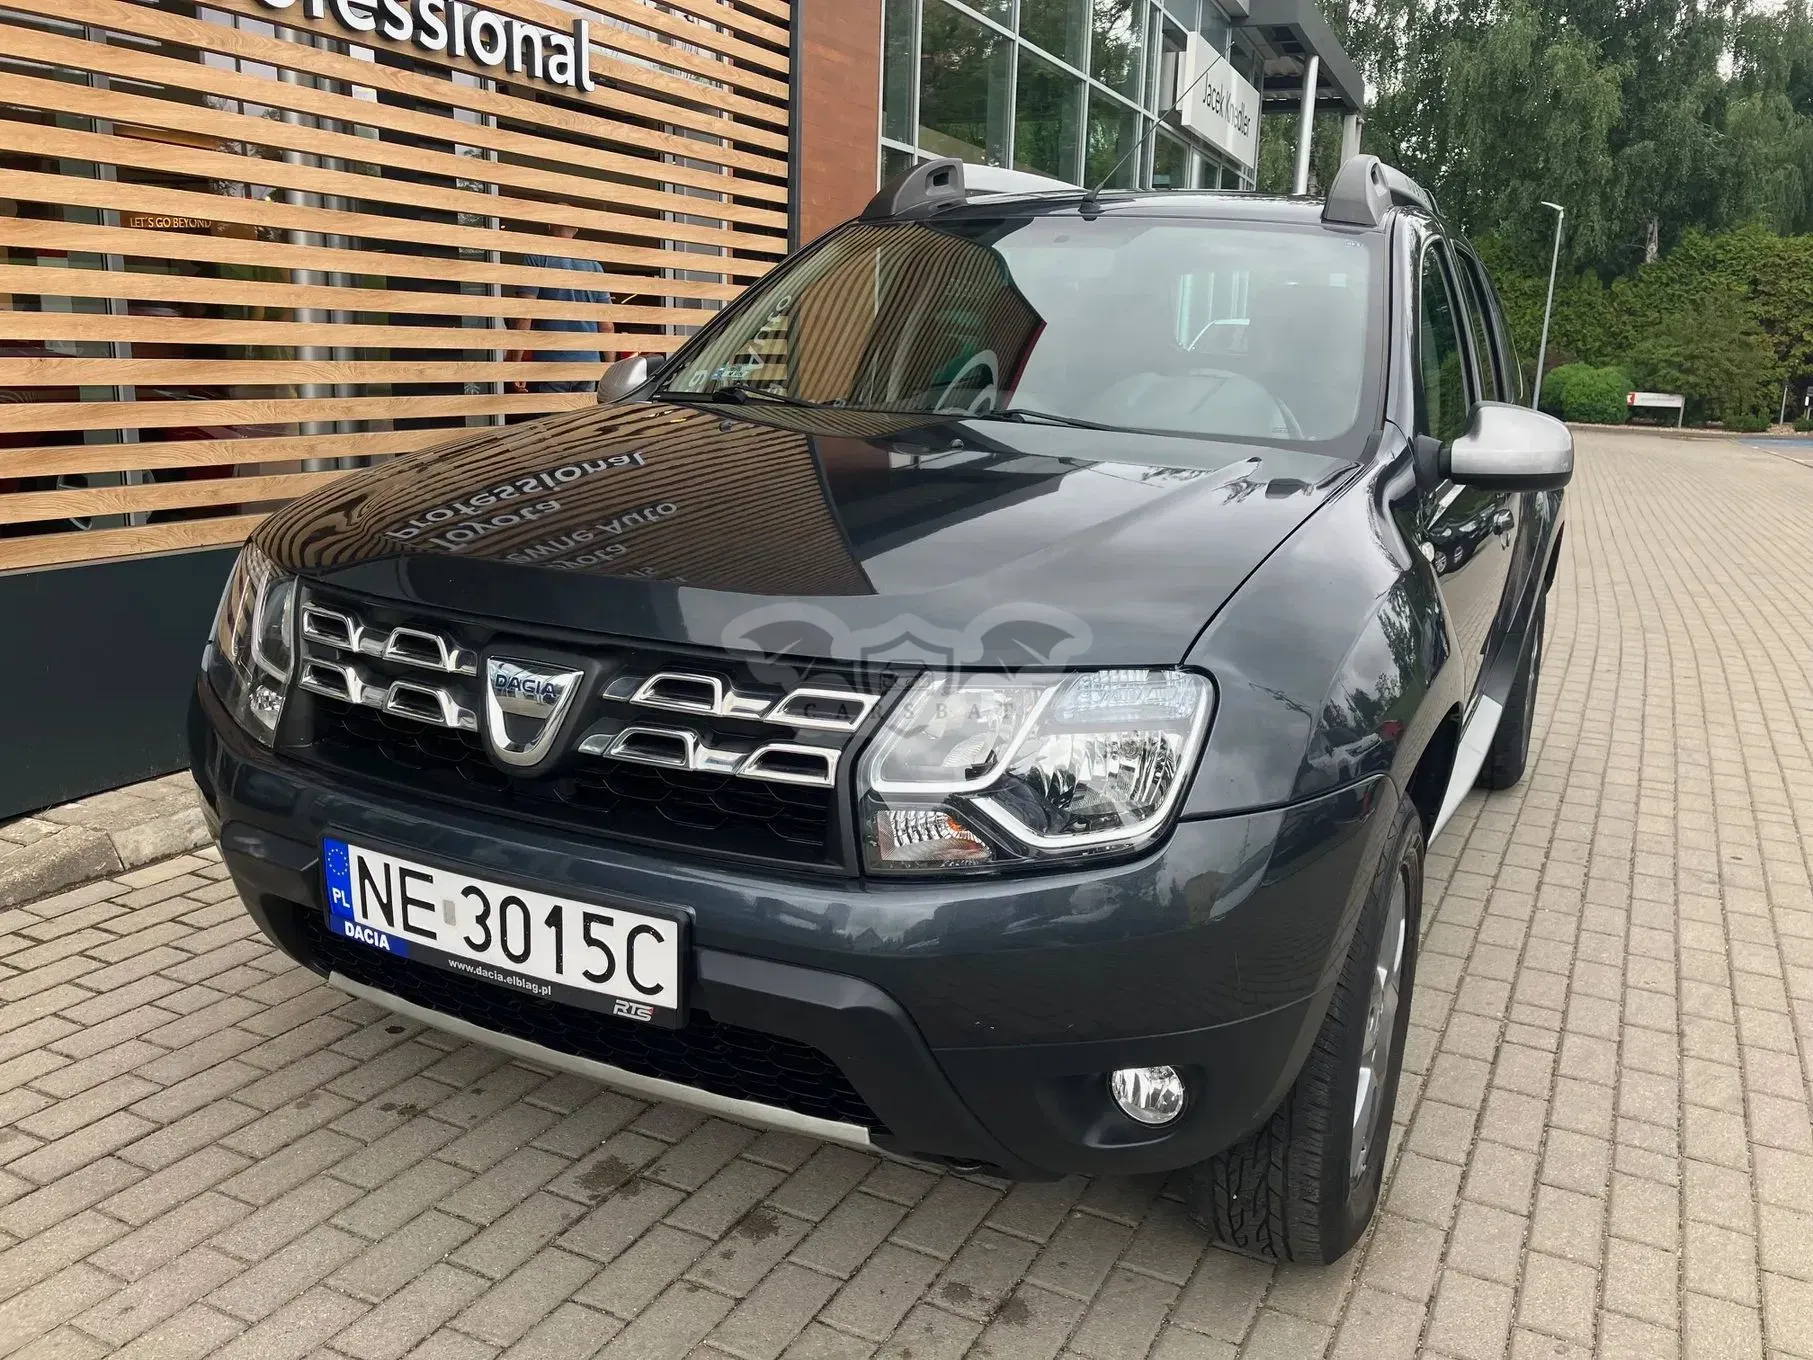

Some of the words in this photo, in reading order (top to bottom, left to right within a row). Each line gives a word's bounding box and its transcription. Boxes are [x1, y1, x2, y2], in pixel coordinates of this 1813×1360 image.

[1203, 72, 1224, 118] Jacek
[155, 217, 170, 228] GO
[173, 217, 211, 228] BEYOND
[495, 674, 557, 698] DACIA
[332, 887, 351, 908] PL
[344, 921, 390, 950] DACIA
[357, 855, 437, 941] NE
[461, 885, 665, 996] 3015C
[448, 958, 552, 996] www.dacia.elblag.pl
[613, 999, 654, 1022] RTS
